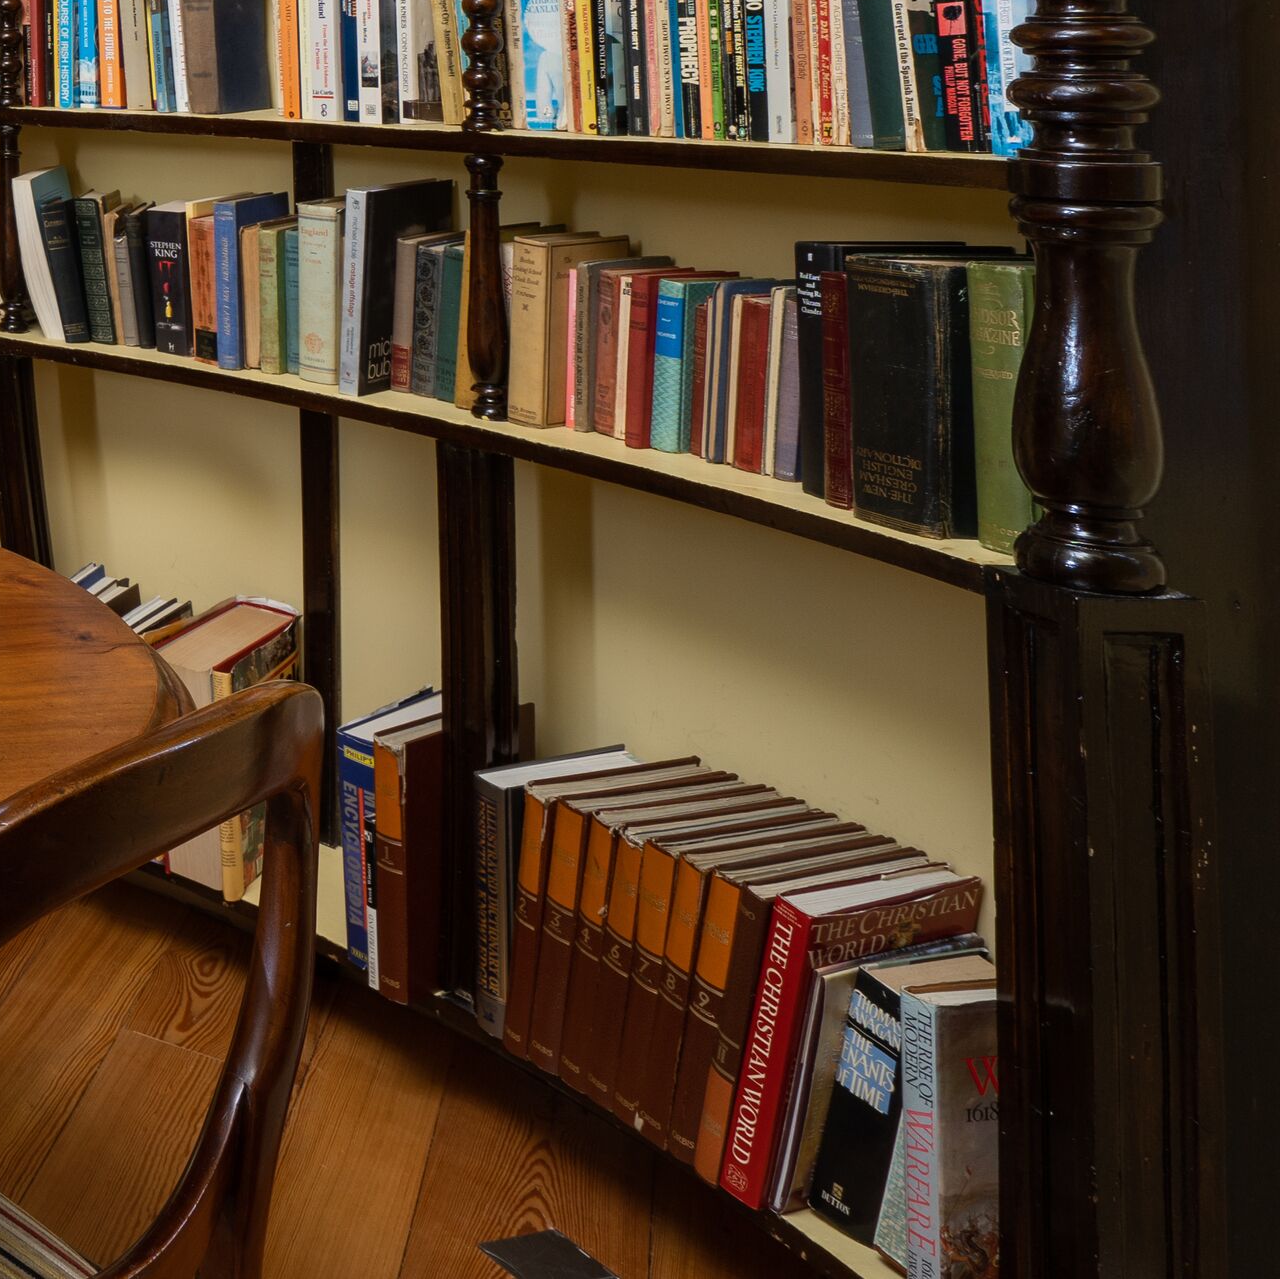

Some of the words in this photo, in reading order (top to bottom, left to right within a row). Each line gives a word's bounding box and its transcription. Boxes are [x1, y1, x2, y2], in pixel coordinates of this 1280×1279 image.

[103, 8, 111, 18] TO
[104, 19, 112, 34] THE
[60, 25, 69, 37] OF
[747, 15, 764, 65] STEPHEN
[60, 38, 69, 58] IRISH
[105, 36, 114, 61] FUTURE
[678, 17, 700, 85] PROPHECY
[60, 59, 69, 101] HISTORY
[749, 66, 764, 93] KING
[150, 240, 182, 250] STEPHEN
[300, 226, 328, 238] England
[154, 248, 178, 259] KING
[345, 749, 373, 767] PHILIP'S
[342, 780, 363, 928] ENCYCLOPEDIA
[774, 920, 794, 962] THE
[807, 935, 886, 969] WORLD
[748, 963, 786, 1084] CHRISTIAN
[729, 1078, 767, 1164] WORLD
[906, 1107, 936, 1257] WARFARE
[820, 1189, 851, 1217] DUTTON
